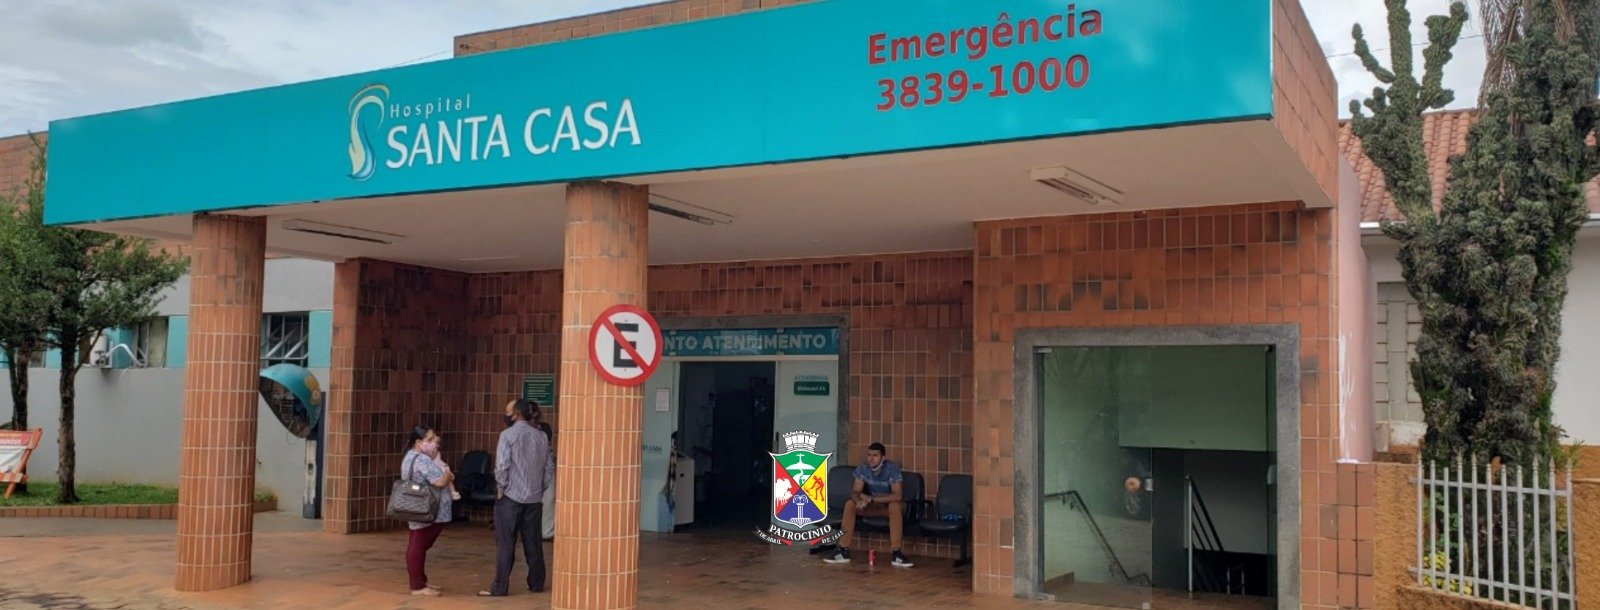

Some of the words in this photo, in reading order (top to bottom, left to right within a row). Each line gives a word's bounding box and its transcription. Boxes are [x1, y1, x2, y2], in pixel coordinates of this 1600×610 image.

[867, 4, 1102, 65] Emergência
[389, 93, 471, 119] Hospital
[876, 54, 1090, 112] 3839-1000
[386, 113, 511, 169] SANTA
[523, 98, 642, 155] CASA
[613, 322, 639, 368] E
[664, 335, 698, 350] NTO
[701, 333, 827, 350] ATENDIMENTO
